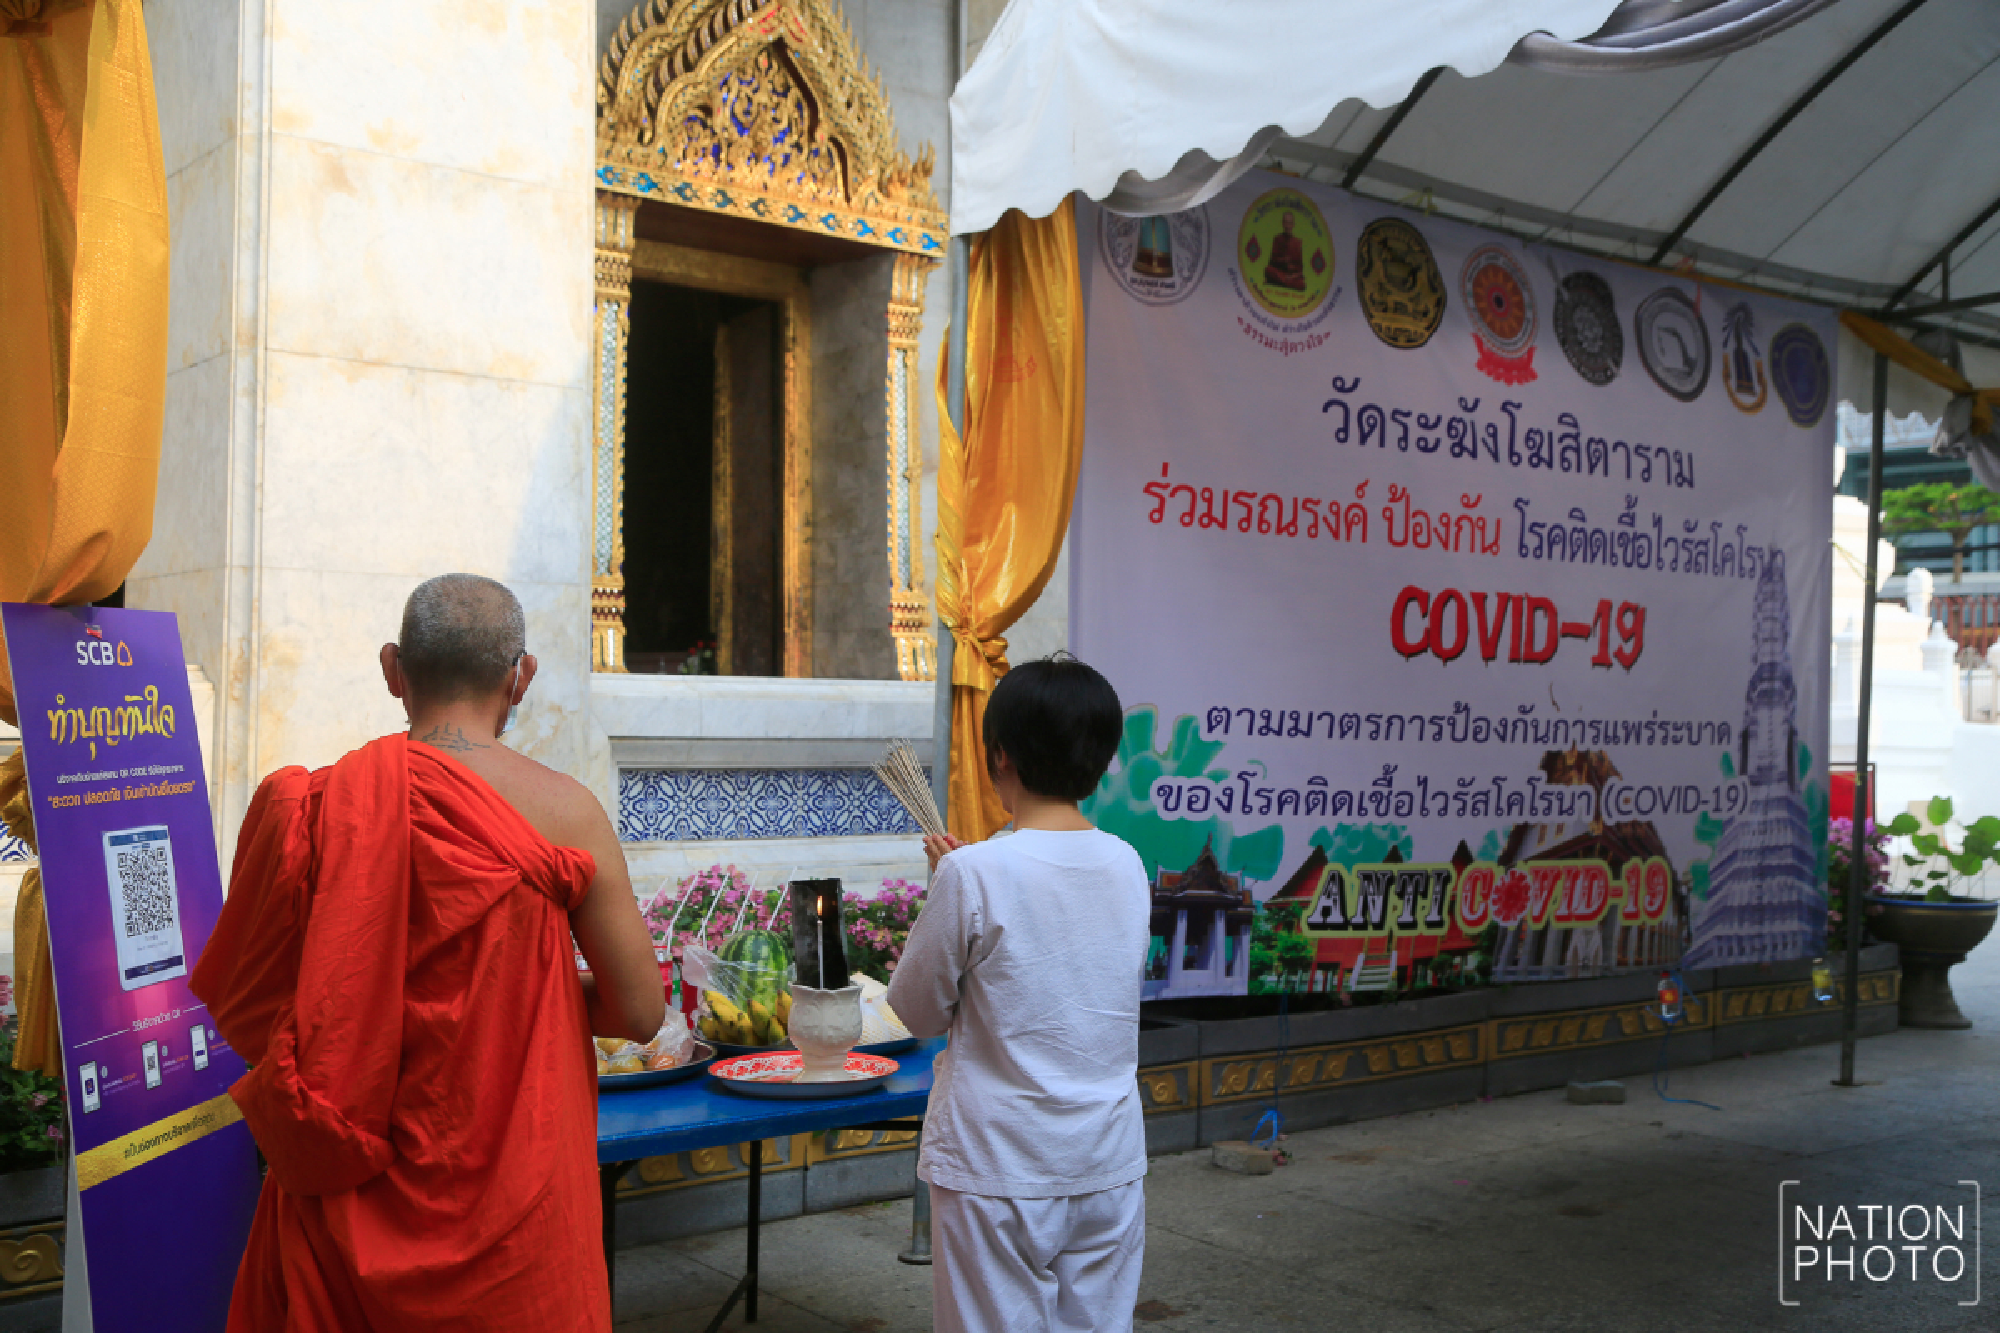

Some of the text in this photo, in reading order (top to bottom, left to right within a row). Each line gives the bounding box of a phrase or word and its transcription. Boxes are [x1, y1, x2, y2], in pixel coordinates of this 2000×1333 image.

[1322, 376, 1695, 488] วัดระฆังโฆสิตาราม
[1142, 462, 1370, 543] ร่วมรณรงค์
[1382, 483, 1501, 557] ป้องกัน
[75, 640, 115, 666] SCB
[1390, 585, 1647, 674] COVID-19
[47, 685, 176, 761] ทำบุญทันใจ
[1206, 701, 1732, 747] ตามมาตรการป้องกันการแพร่ระบาด
[1156, 763, 1749, 818] ของโรคติดเชื้อไวรัสโคโรนา (COVID-19)
[1307, 868, 1452, 931] ANTI
